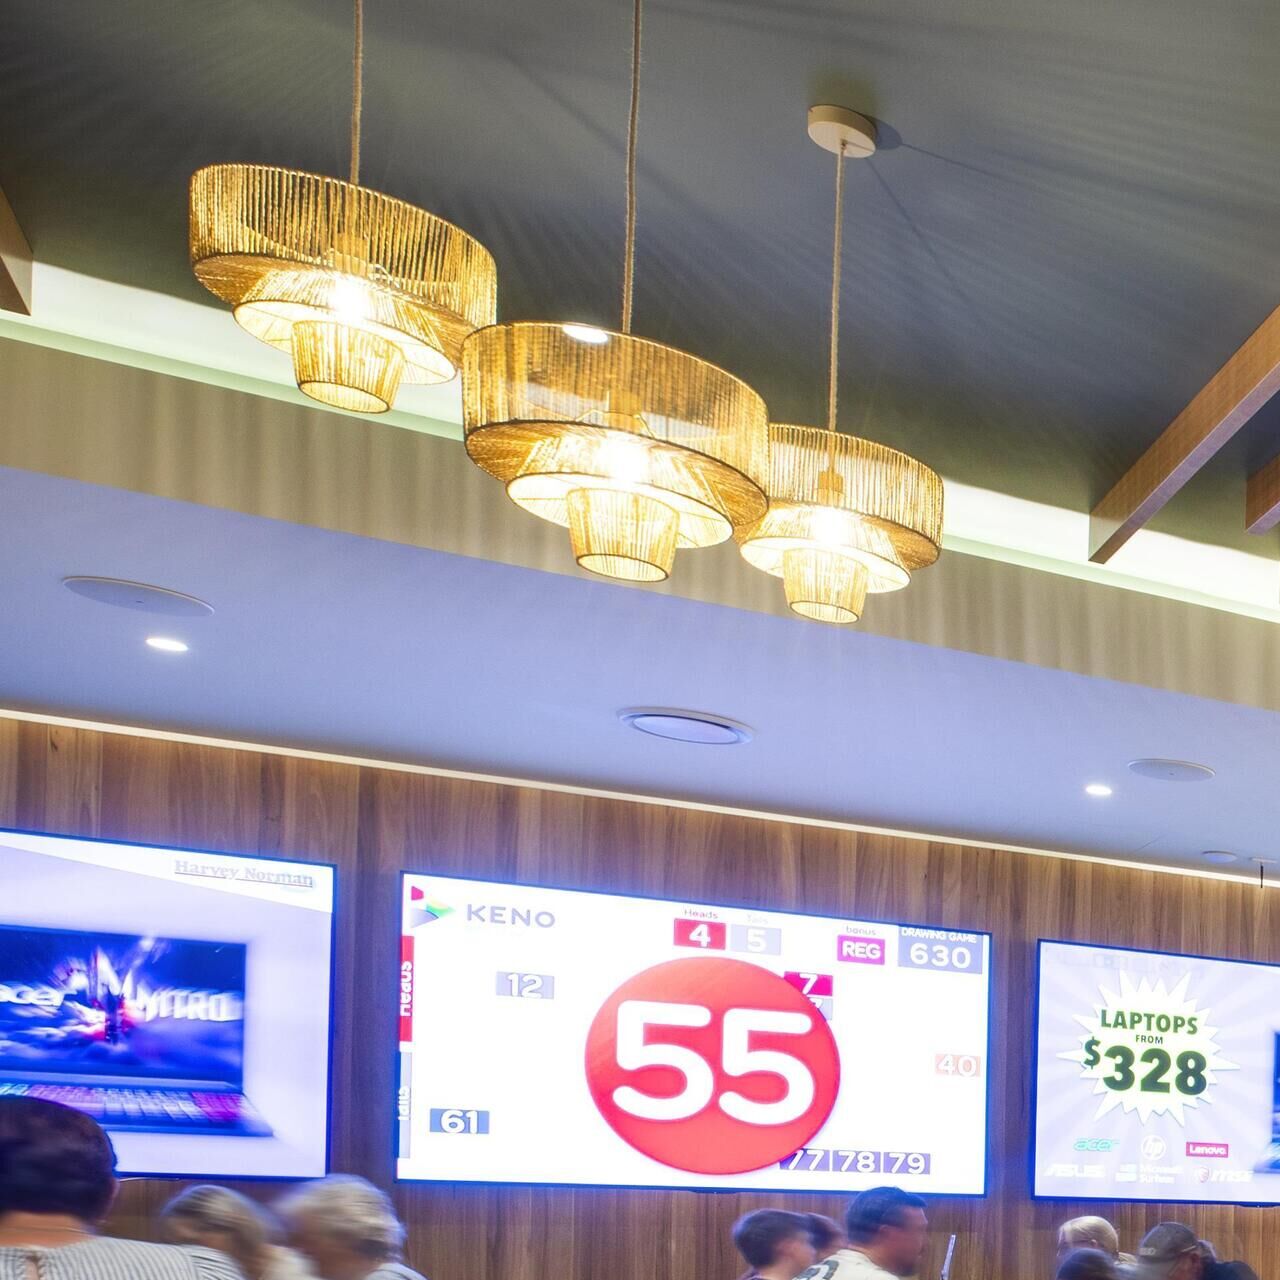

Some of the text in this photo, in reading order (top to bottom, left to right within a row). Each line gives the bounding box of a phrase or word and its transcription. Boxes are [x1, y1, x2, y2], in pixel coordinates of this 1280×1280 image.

[174, 860, 314, 887] Harvey Norman
[467, 903, 556, 929] KENO
[684, 909, 719, 919] Heads
[688, 923, 711, 948] 4
[746, 927, 768, 951] 5
[846, 925, 877, 936] bonus
[901, 928, 977, 943] DRAWING GAME
[842, 940, 881, 960] REG
[910, 942, 971, 969] 630
[507, 972, 543, 999] 12
[799, 972, 819, 995] 7
[1100, 1008, 1199, 1035] LAPTOPS
[1135, 1034, 1164, 1045] FROM
[612, 999, 816, 1126] 55
[936, 1055, 977, 1078] 40
[1083, 1036, 1207, 1096] $328
[440, 1108, 478, 1135] 61
[1074, 1138, 1120, 1152] acer
[1188, 1144, 1227, 1156] Lenovo
[838, 1150, 876, 1173] 78
[888, 1152, 926, 1175] 79
